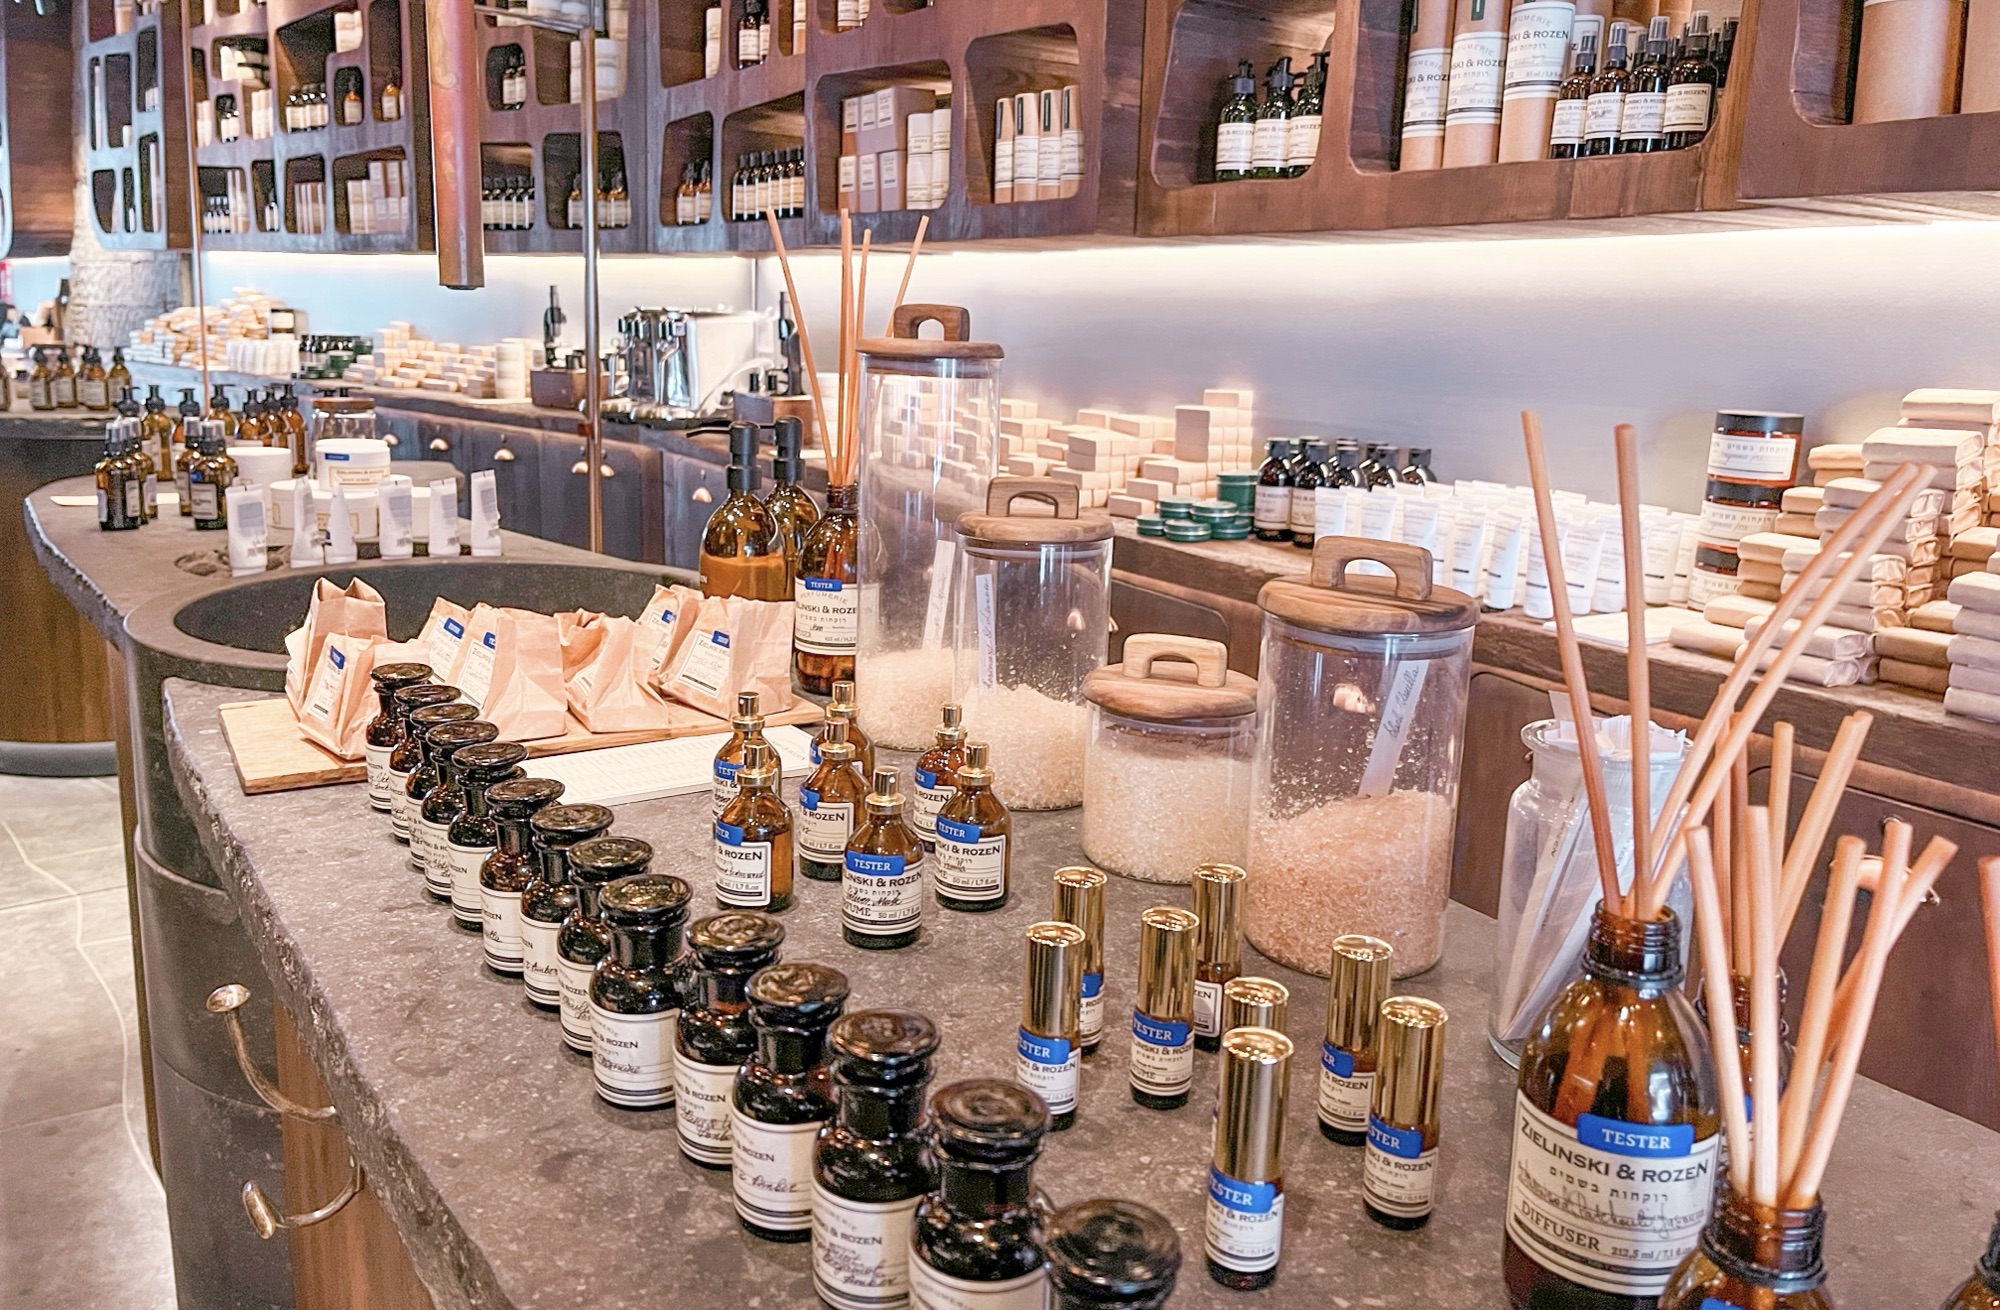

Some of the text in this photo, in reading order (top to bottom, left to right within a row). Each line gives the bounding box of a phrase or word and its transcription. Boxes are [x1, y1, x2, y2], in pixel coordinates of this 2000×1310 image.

[1522, 32, 1532, 40] &
[1533, 30, 1569, 40] ROZEN
[1466, 58, 1474, 67] &
[810, 581, 833, 589] TESTER
[822, 605, 830, 614] &
[809, 812, 845, 822] ROZEN
[937, 821, 966, 838] TESTER
[724, 849, 762, 860] ROZEN
[951, 844, 960, 854] &
[962, 844, 1000, 856] ROZEN
[854, 858, 891, 871] TESTER
[876, 877, 886, 887] &
[889, 872, 922, 887] ROZEN
[878, 911, 887, 919] 50
[606, 1038, 639, 1049] ROZEN
[1161, 1046, 1170, 1056] &
[1031, 1060, 1077, 1074] & ROZEN
[1325, 1073, 1369, 1090] & ROZEN
[692, 1090, 727, 1102] ROZEN
[1601, 1127, 1671, 1150] TESTER
[742, 1146, 775, 1163] ROZEN
[1519, 1116, 1710, 1183] ZIELINSKI & ROZEN
[1382, 1156, 1392, 1167] &
[1394, 1160, 1432, 1173] ROZEN
[1549, 1165, 1600, 1194] בשמים
[1609, 1188, 1669, 1204] רוקחות
[1226, 1209, 1279, 1223] & ROZEN
[1521, 1199, 1600, 1251] DIFFUSER
[1641, 1251, 1653, 1259] ml
[840, 1232, 882, 1246] ROZEN
